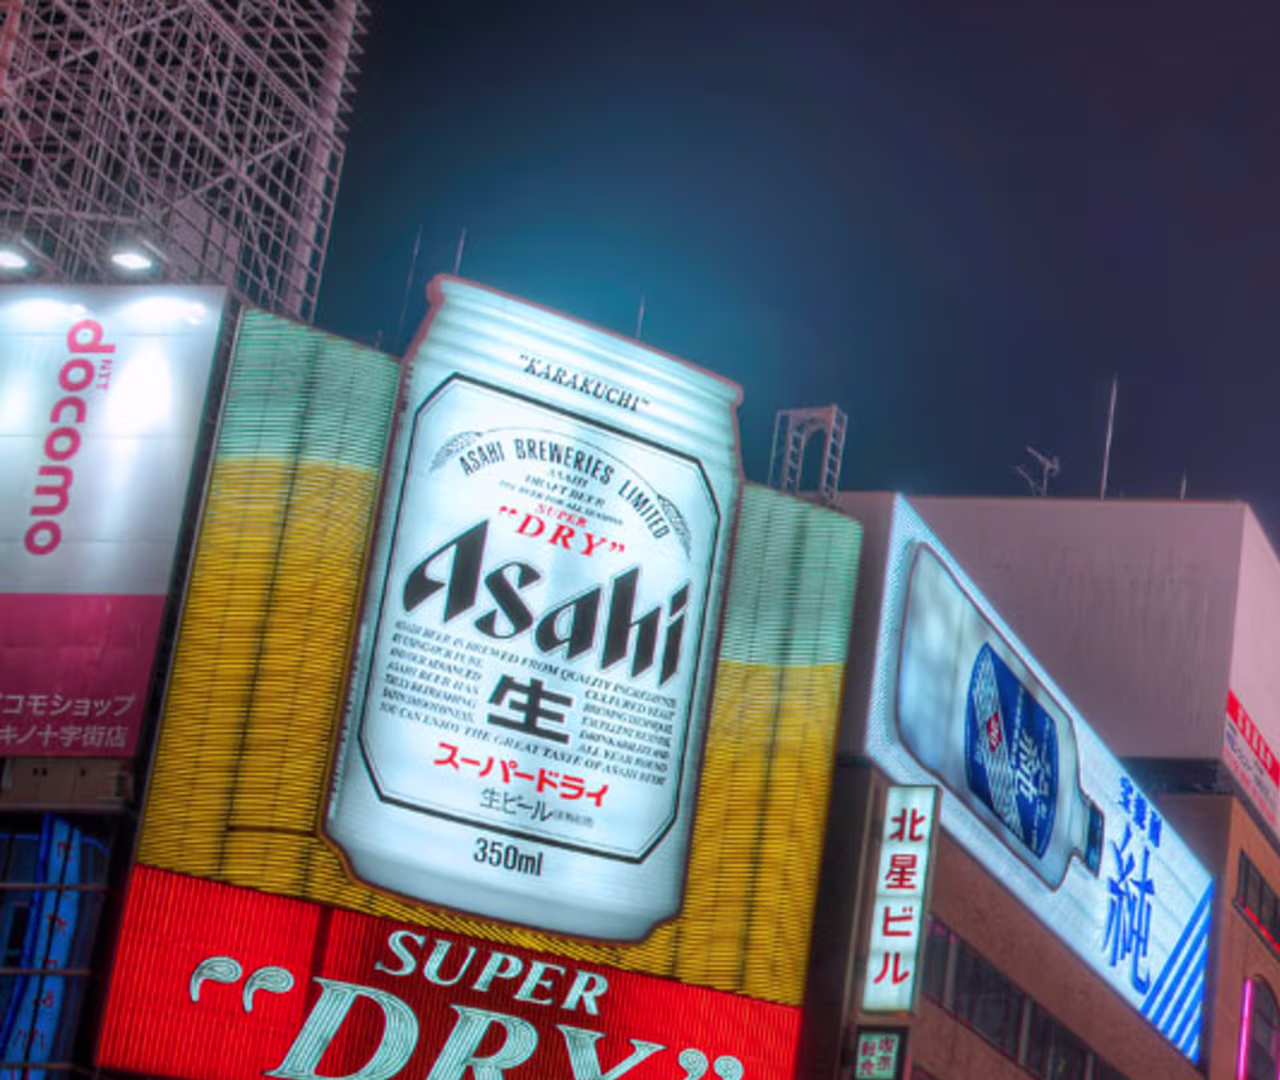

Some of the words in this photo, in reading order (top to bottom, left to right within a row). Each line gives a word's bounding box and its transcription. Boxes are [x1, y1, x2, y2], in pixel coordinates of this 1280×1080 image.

[23, 319, 104, 557] docomo
[459, 440, 505, 476] ASAHI
[513, 438, 616, 486] BREWERIES
[617, 479, 671, 540] LIMITED
[535, 502, 588, 529] SUPER
[402, 518, 695, 688] Asahi
[0, 691, 137, 717] コモショップ
[486, 673, 573, 745] 生
[433, 741, 609, 807] スーパードライ
[540, 744, 583, 766] TASTE
[472, 835, 545, 877] 350ml
[871, 807, 925, 986] 北星ビル
[374, 929, 610, 1017] SUPER
